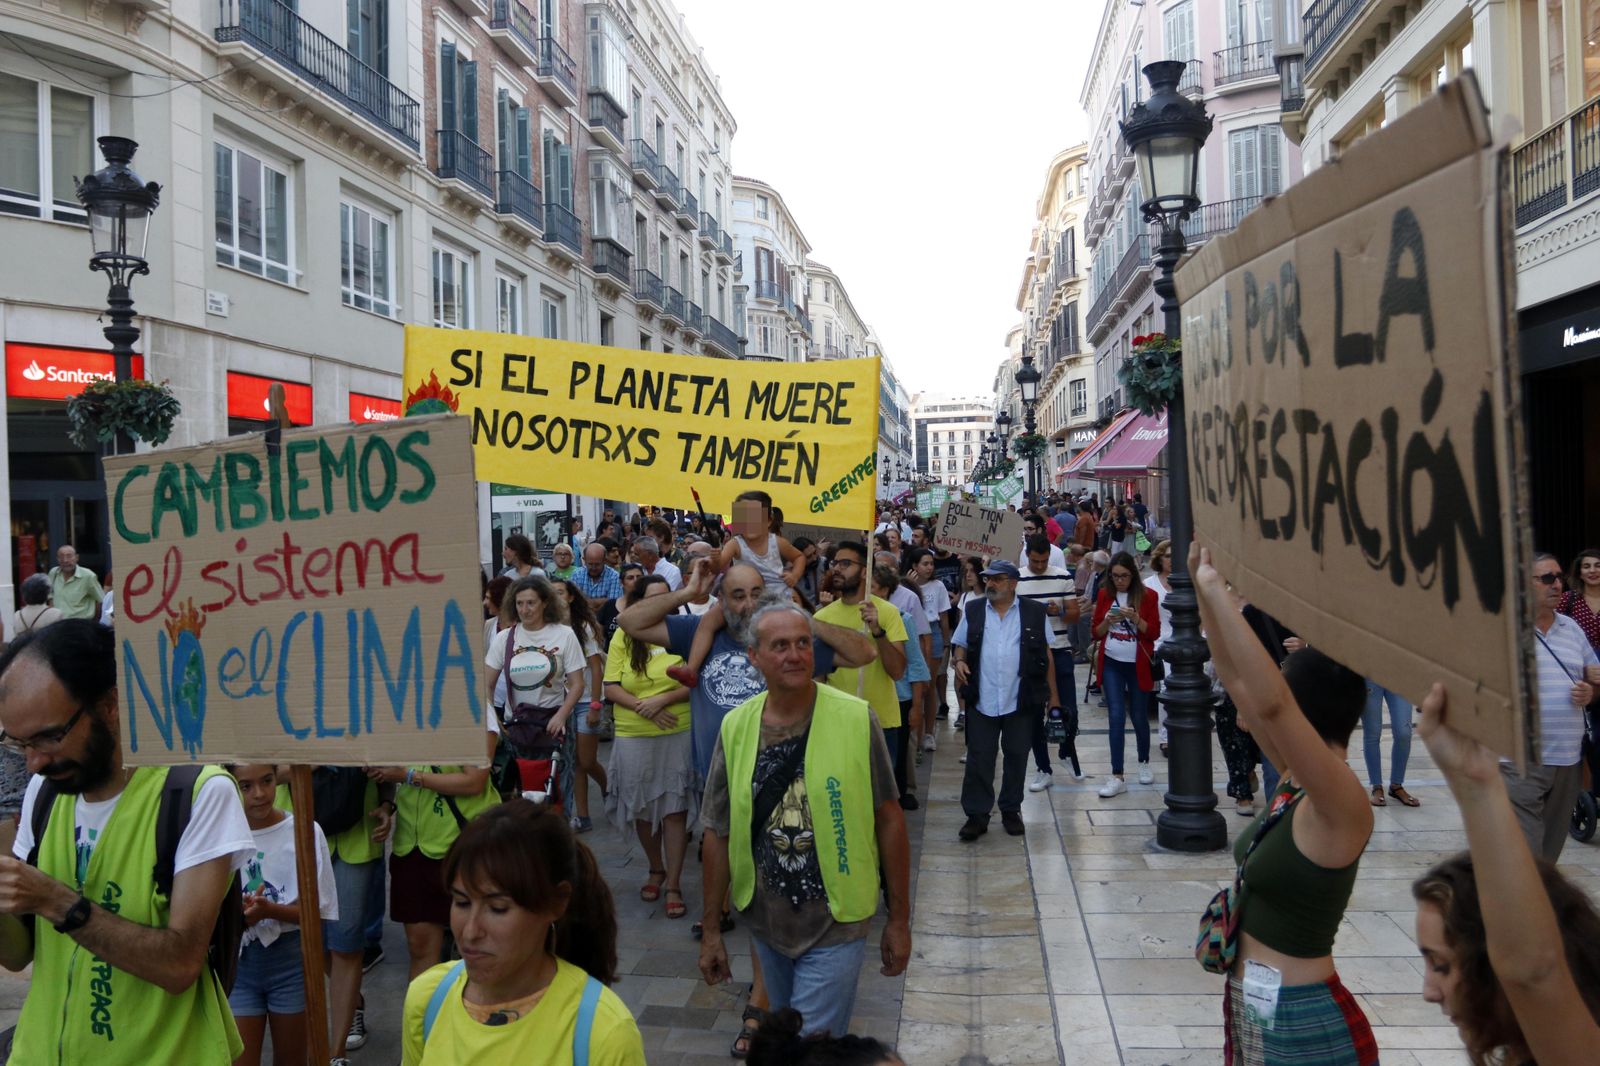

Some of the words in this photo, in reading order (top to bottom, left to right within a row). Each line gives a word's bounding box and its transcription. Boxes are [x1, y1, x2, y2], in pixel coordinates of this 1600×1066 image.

[1243, 260, 1311, 369] POR
[1332, 206, 1436, 370] LA
[47, 366, 116, 384] Santand
[449, 348, 483, 388] SI
[500, 353, 549, 397] EL
[569, 361, 731, 419] PLANETA
[744, 380, 856, 427] MUERE
[114, 431, 437, 544] CAMBIEMOS
[471, 407, 660, 467] NOSOTRXS
[677, 429, 821, 487] TAMBIÉN
[946, 514, 957, 526] ED
[988, 522, 998, 534] N
[947, 502, 972, 518] POLL
[980, 508, 1004, 524] TION
[1191, 367, 1506, 614] REFORESTACIÓN
[942, 525, 949, 537] S
[981, 533, 989, 543] N
[965, 540, 1002, 557] MISSING?
[123, 546, 184, 623] el
[198, 532, 445, 613] sistema
[122, 628, 207, 759] NO
[217, 627, 274, 699] el
[275, 599, 482, 741] CLIMA
[825, 776, 850, 876] GREENPEACE
[90, 880, 123, 1042] GRPEACE
